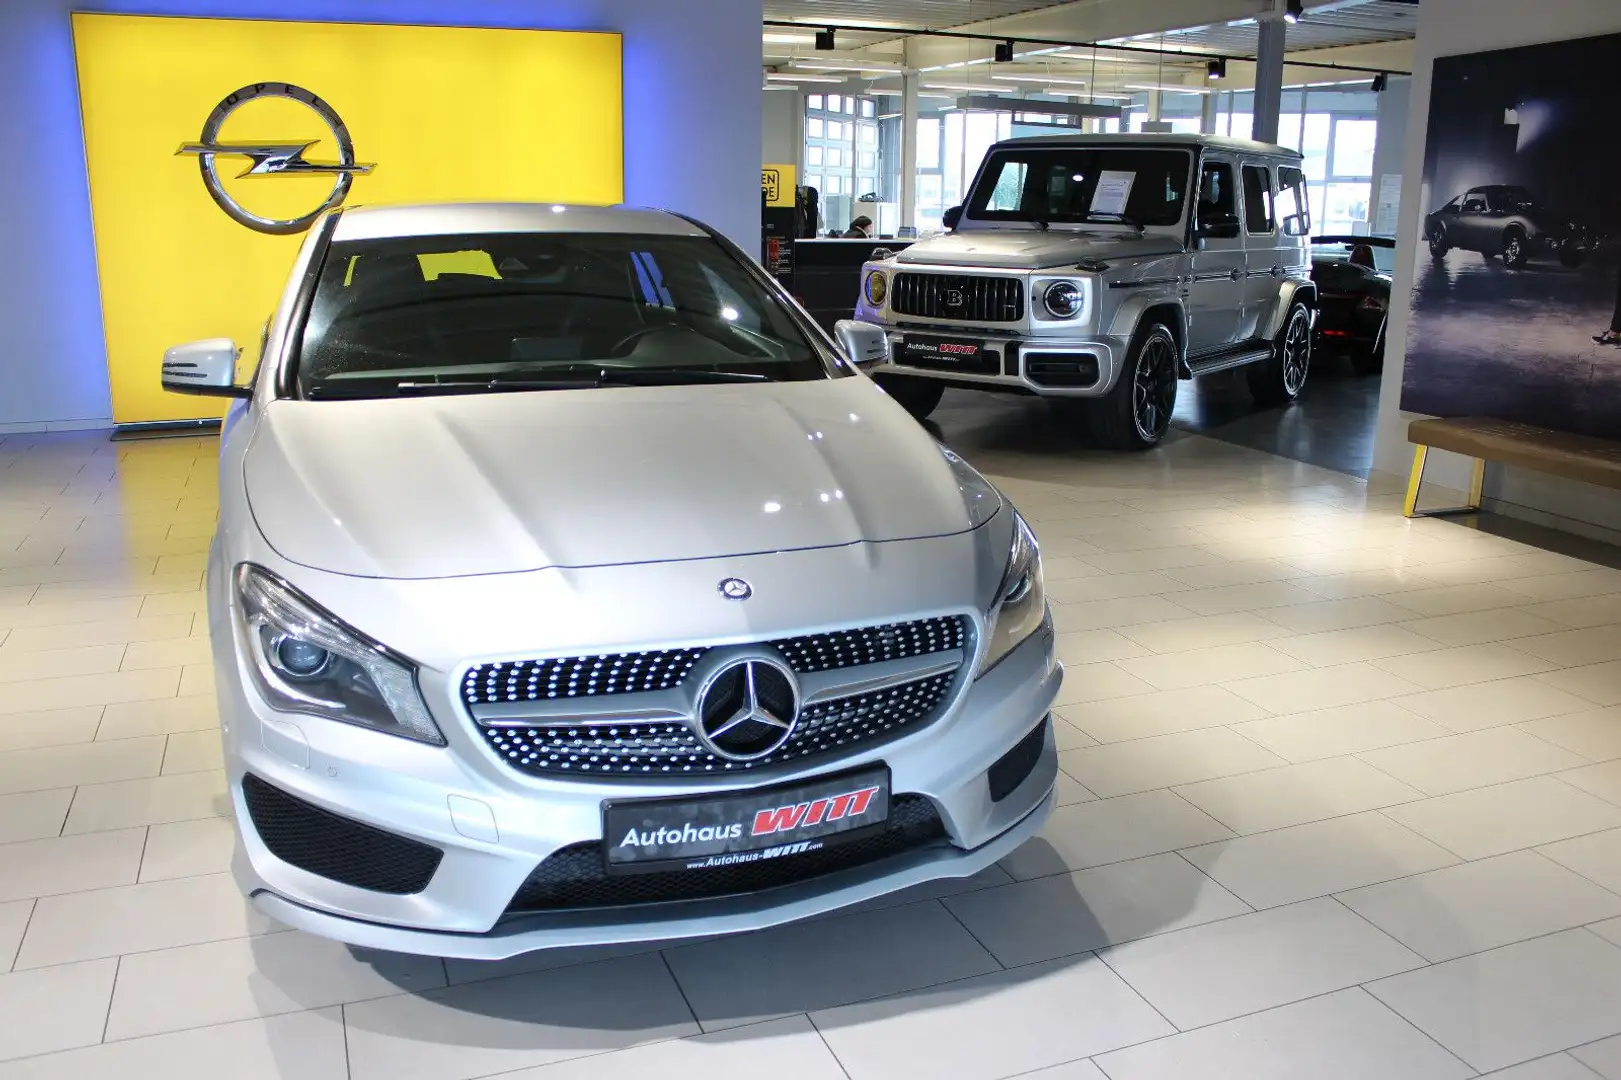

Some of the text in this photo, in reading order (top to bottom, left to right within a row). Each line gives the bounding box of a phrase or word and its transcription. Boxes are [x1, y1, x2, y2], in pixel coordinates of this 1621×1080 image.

[227, 83, 322, 107] OPEL
[907, 343, 937, 351] Autohaus
[620, 786, 880, 848] Autohaus WITT
[686, 841, 823, 869] www.Autohaus-WITT.com
